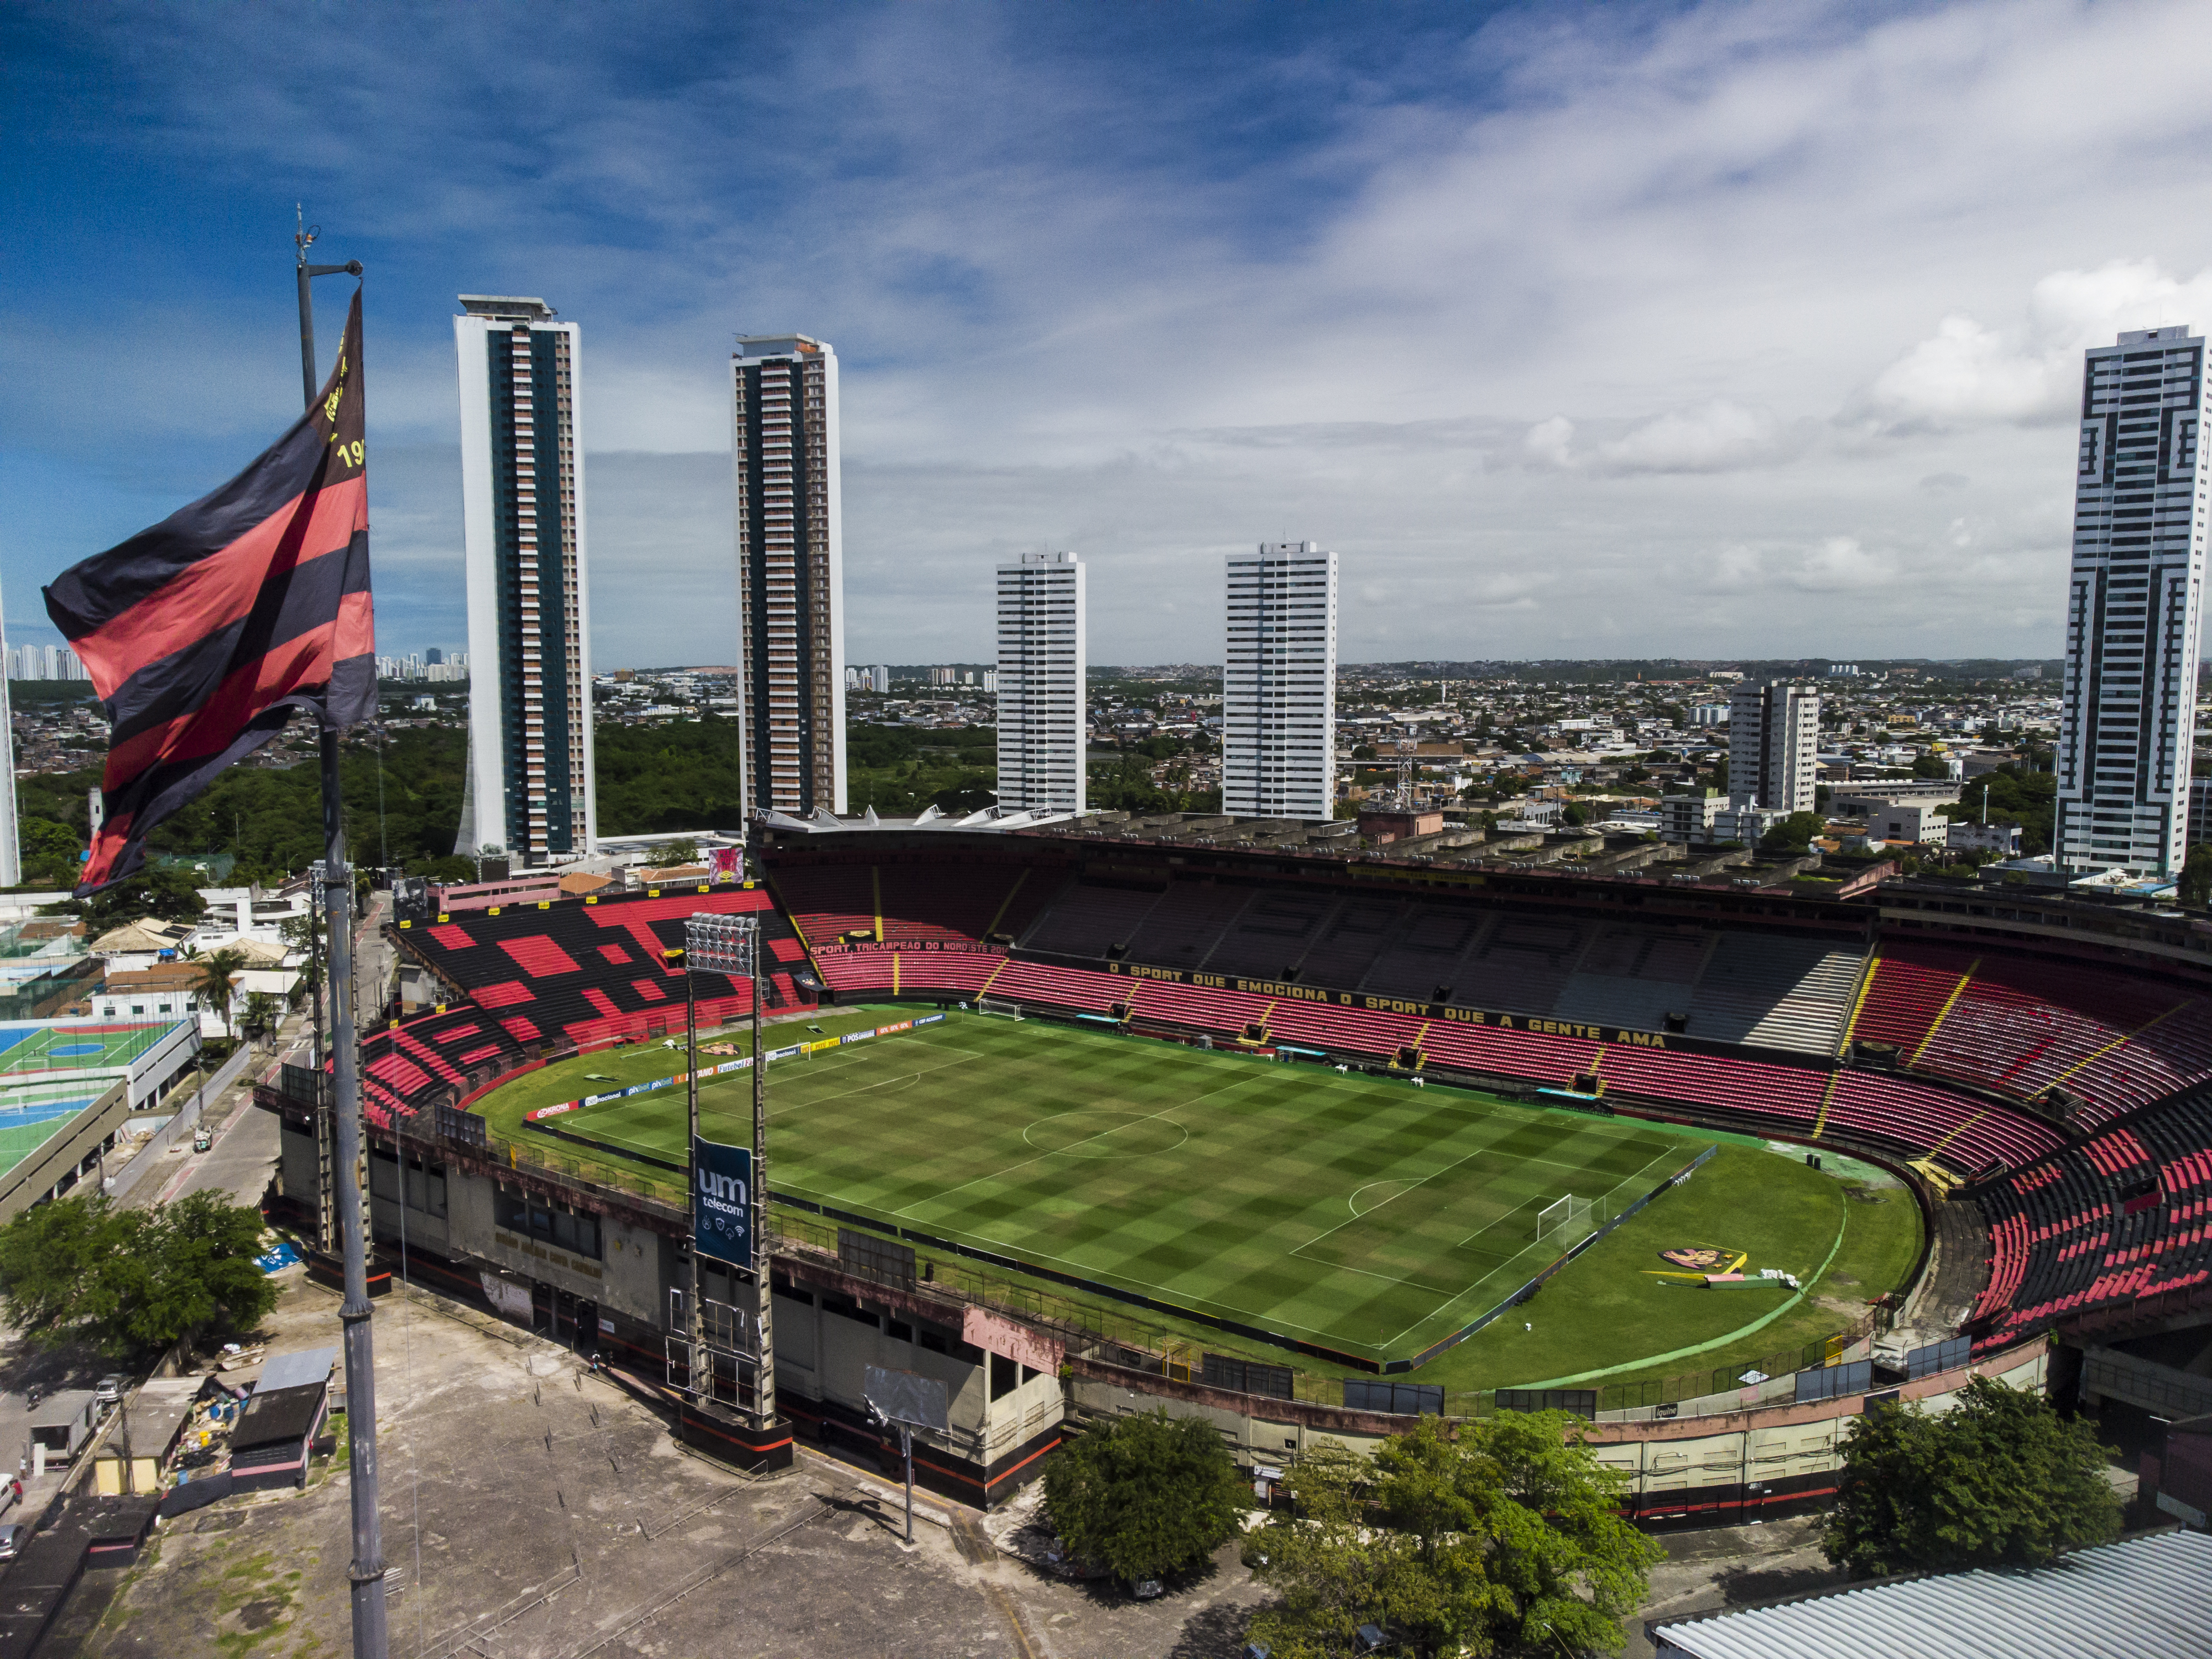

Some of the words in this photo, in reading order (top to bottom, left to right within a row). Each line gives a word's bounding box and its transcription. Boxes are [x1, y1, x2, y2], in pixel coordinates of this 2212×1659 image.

[810, 944, 851, 956] SPORT
[926, 942, 939, 950] DO
[1109, 963, 1119, 973] O
[1130, 966, 1182, 982] SPORT
[1193, 974, 1225, 988] QUE
[1238, 980, 1328, 1002] EMOCIONA
[1340, 994, 1352, 1005] O
[1366, 997, 1430, 1016] SPORT
[1444, 1007, 1485, 1024] QUE
[1500, 1016, 1514, 1028] A
[1528, 1019, 1601, 1040] GENTE
[1617, 1031, 1666, 1048] AMA
[719, 1060, 744, 1073] Futebol
[547, 1103, 570, 1115] KRONA
[698, 1167, 747, 1205] um
[703, 1196, 744, 1218] telecom
[1656, 1407, 1677, 1418] Iquine
